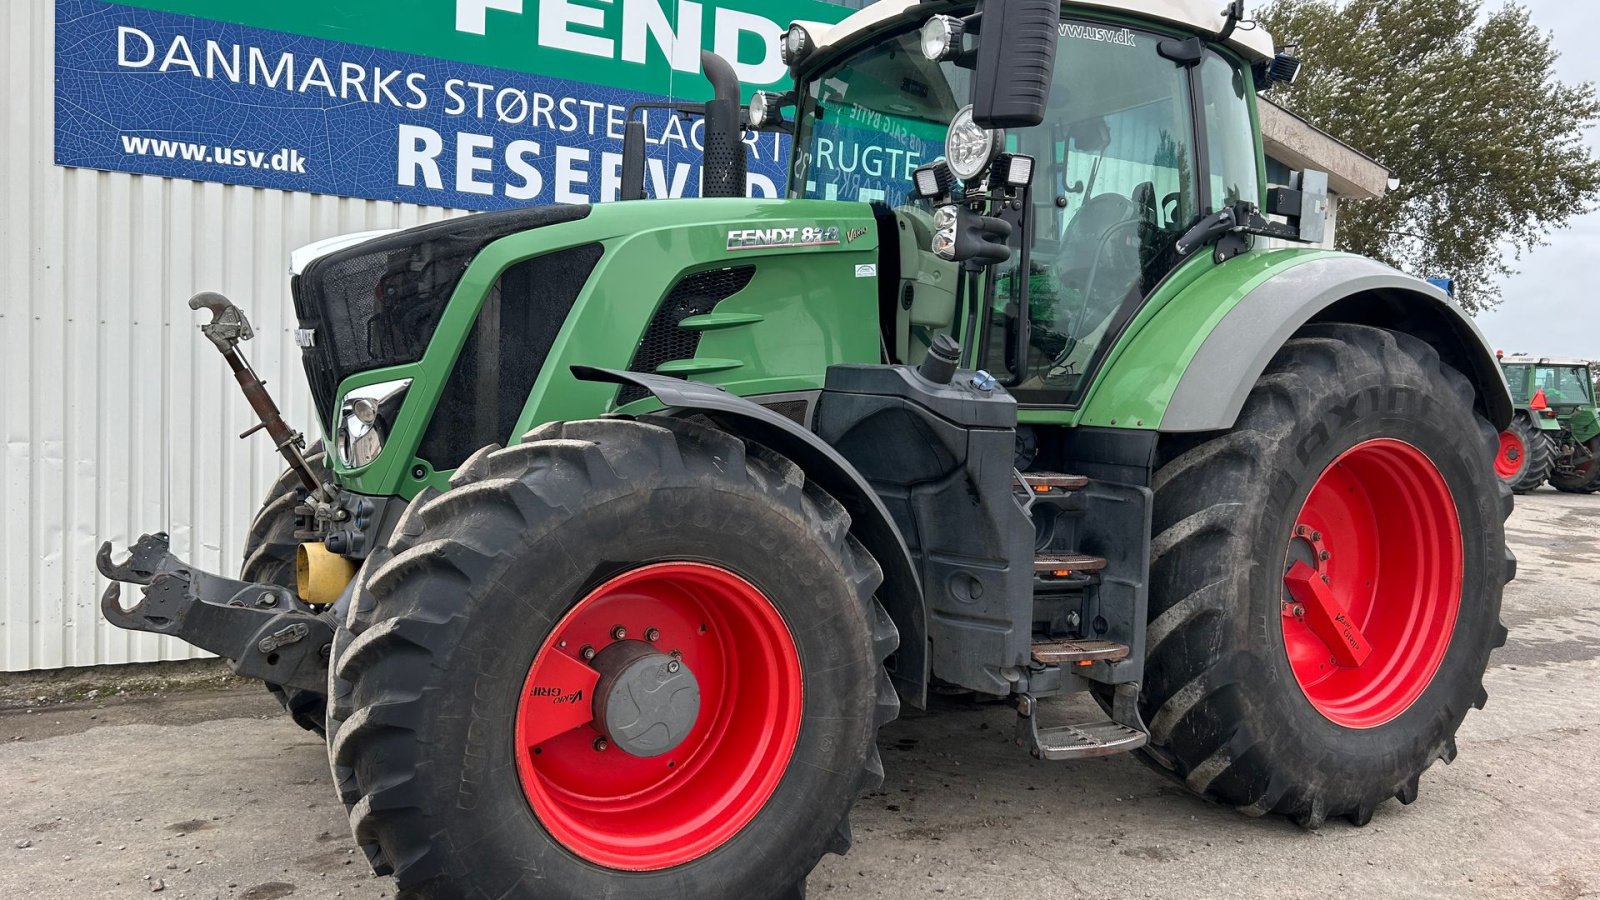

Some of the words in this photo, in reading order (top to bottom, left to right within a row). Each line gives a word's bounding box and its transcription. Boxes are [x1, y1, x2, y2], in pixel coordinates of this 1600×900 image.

[117, 26, 427, 111] DANMARKS
[444, 79, 627, 140] STØRSTE
[642, 109, 760, 160] LAR
[809, 137, 920, 182] RUGTE
[121, 135, 306, 174] www.usv.dk
[727, 228, 799, 248] FENDT
